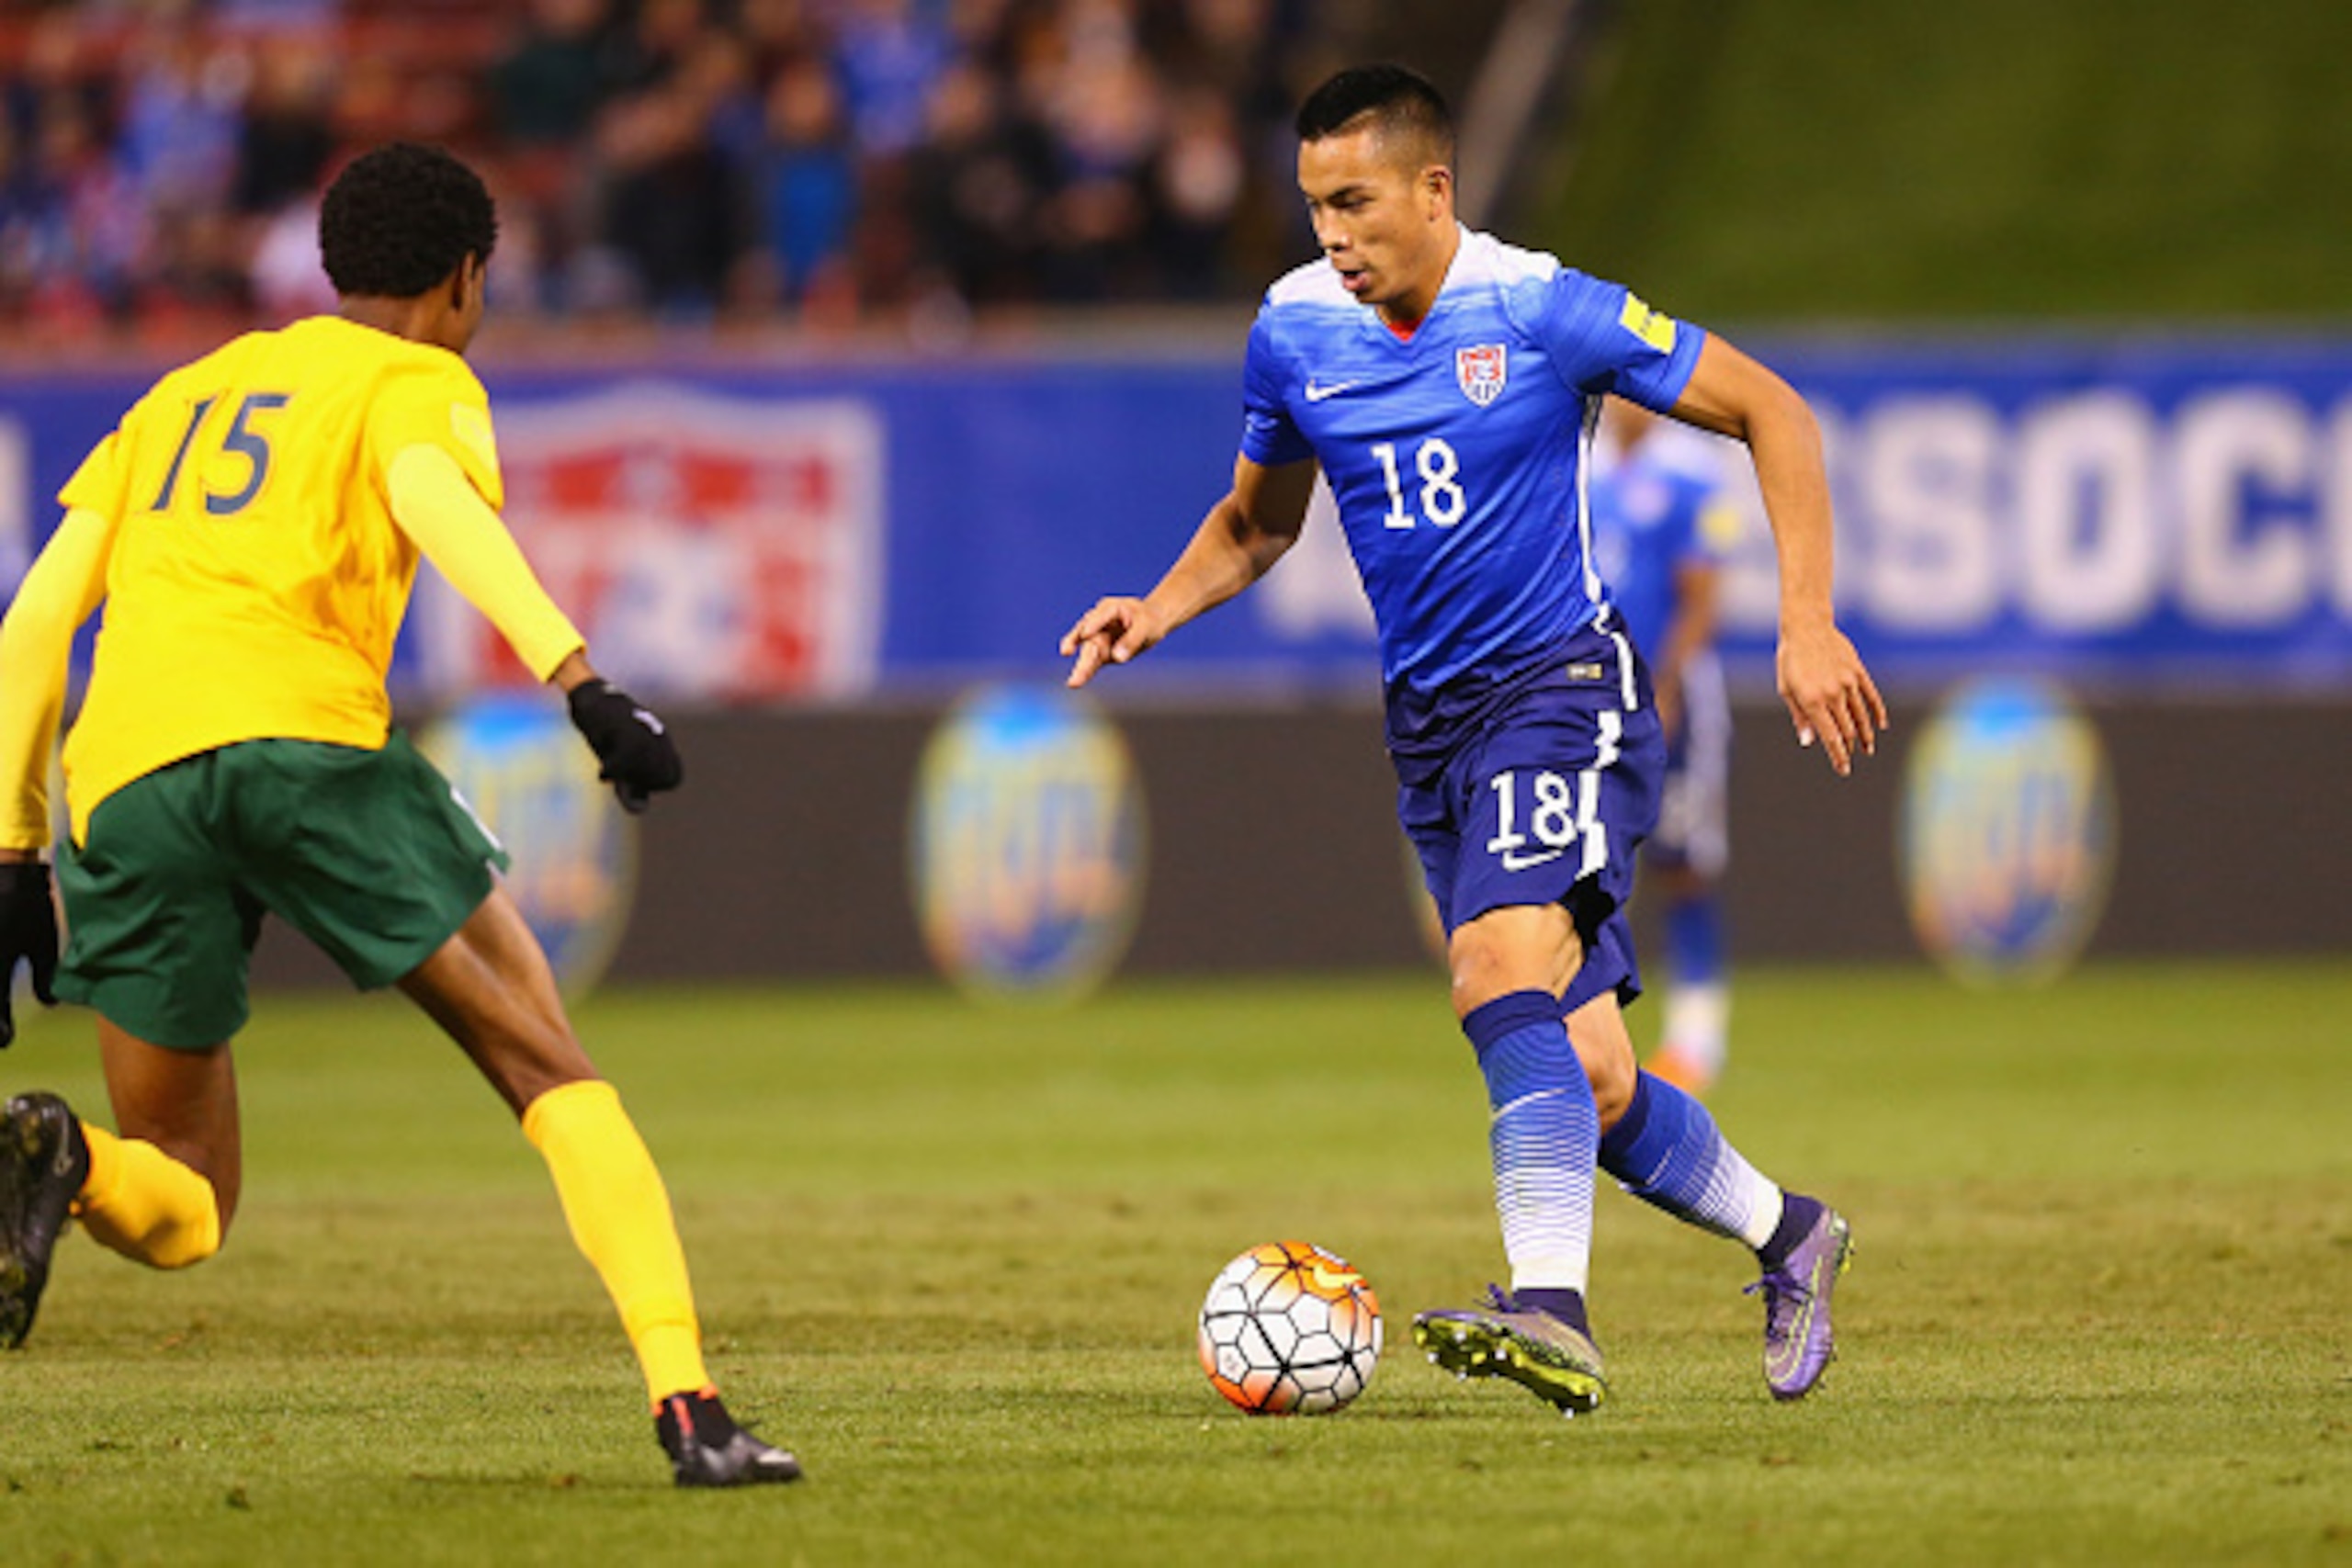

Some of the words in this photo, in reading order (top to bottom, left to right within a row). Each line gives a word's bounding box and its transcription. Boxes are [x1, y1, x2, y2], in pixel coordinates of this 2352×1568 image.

[150, 394, 290, 514] 15
[1371, 437, 1467, 528] 18
[1487, 771, 1577, 852] 18
